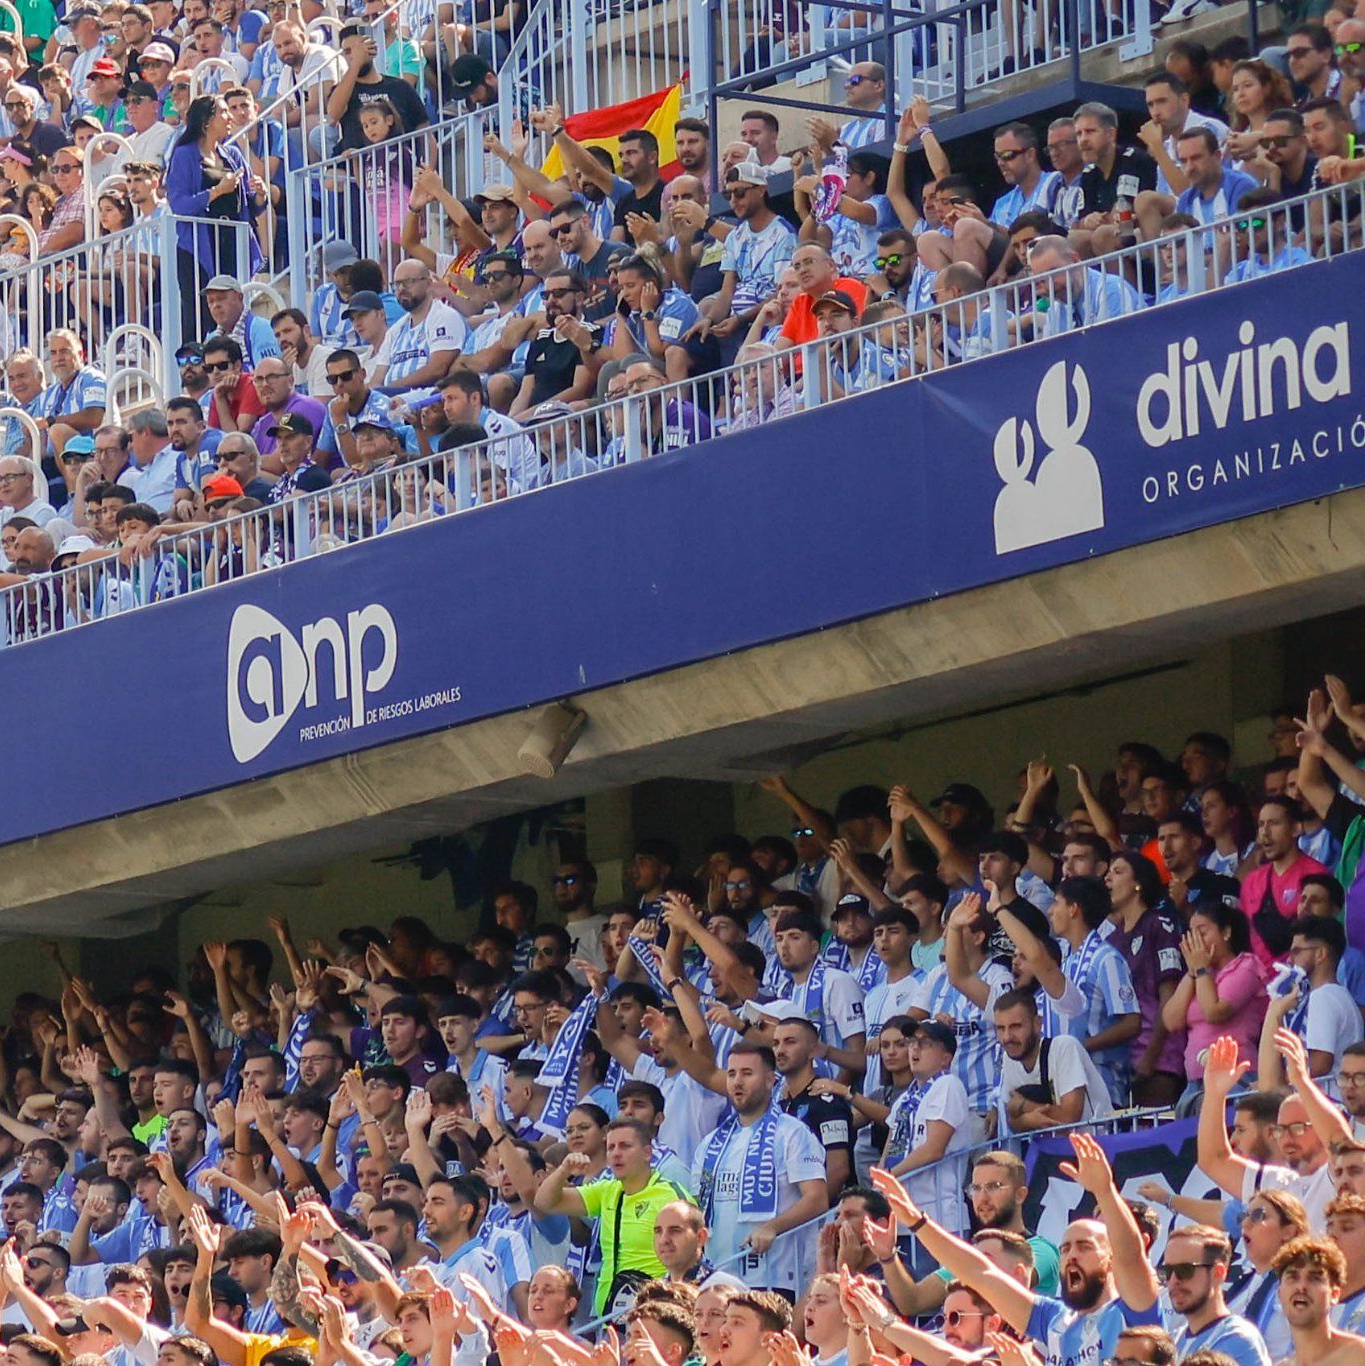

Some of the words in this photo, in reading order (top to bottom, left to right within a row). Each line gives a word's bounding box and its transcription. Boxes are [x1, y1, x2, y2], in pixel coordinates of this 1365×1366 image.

[1137, 321, 1351, 447] divina
[300, 716, 350, 742] PREVENCIÓN
[366, 709, 378, 725] DE
[378, 700, 413, 721] RIESGOS
[414, 687, 461, 713] LABORALES
